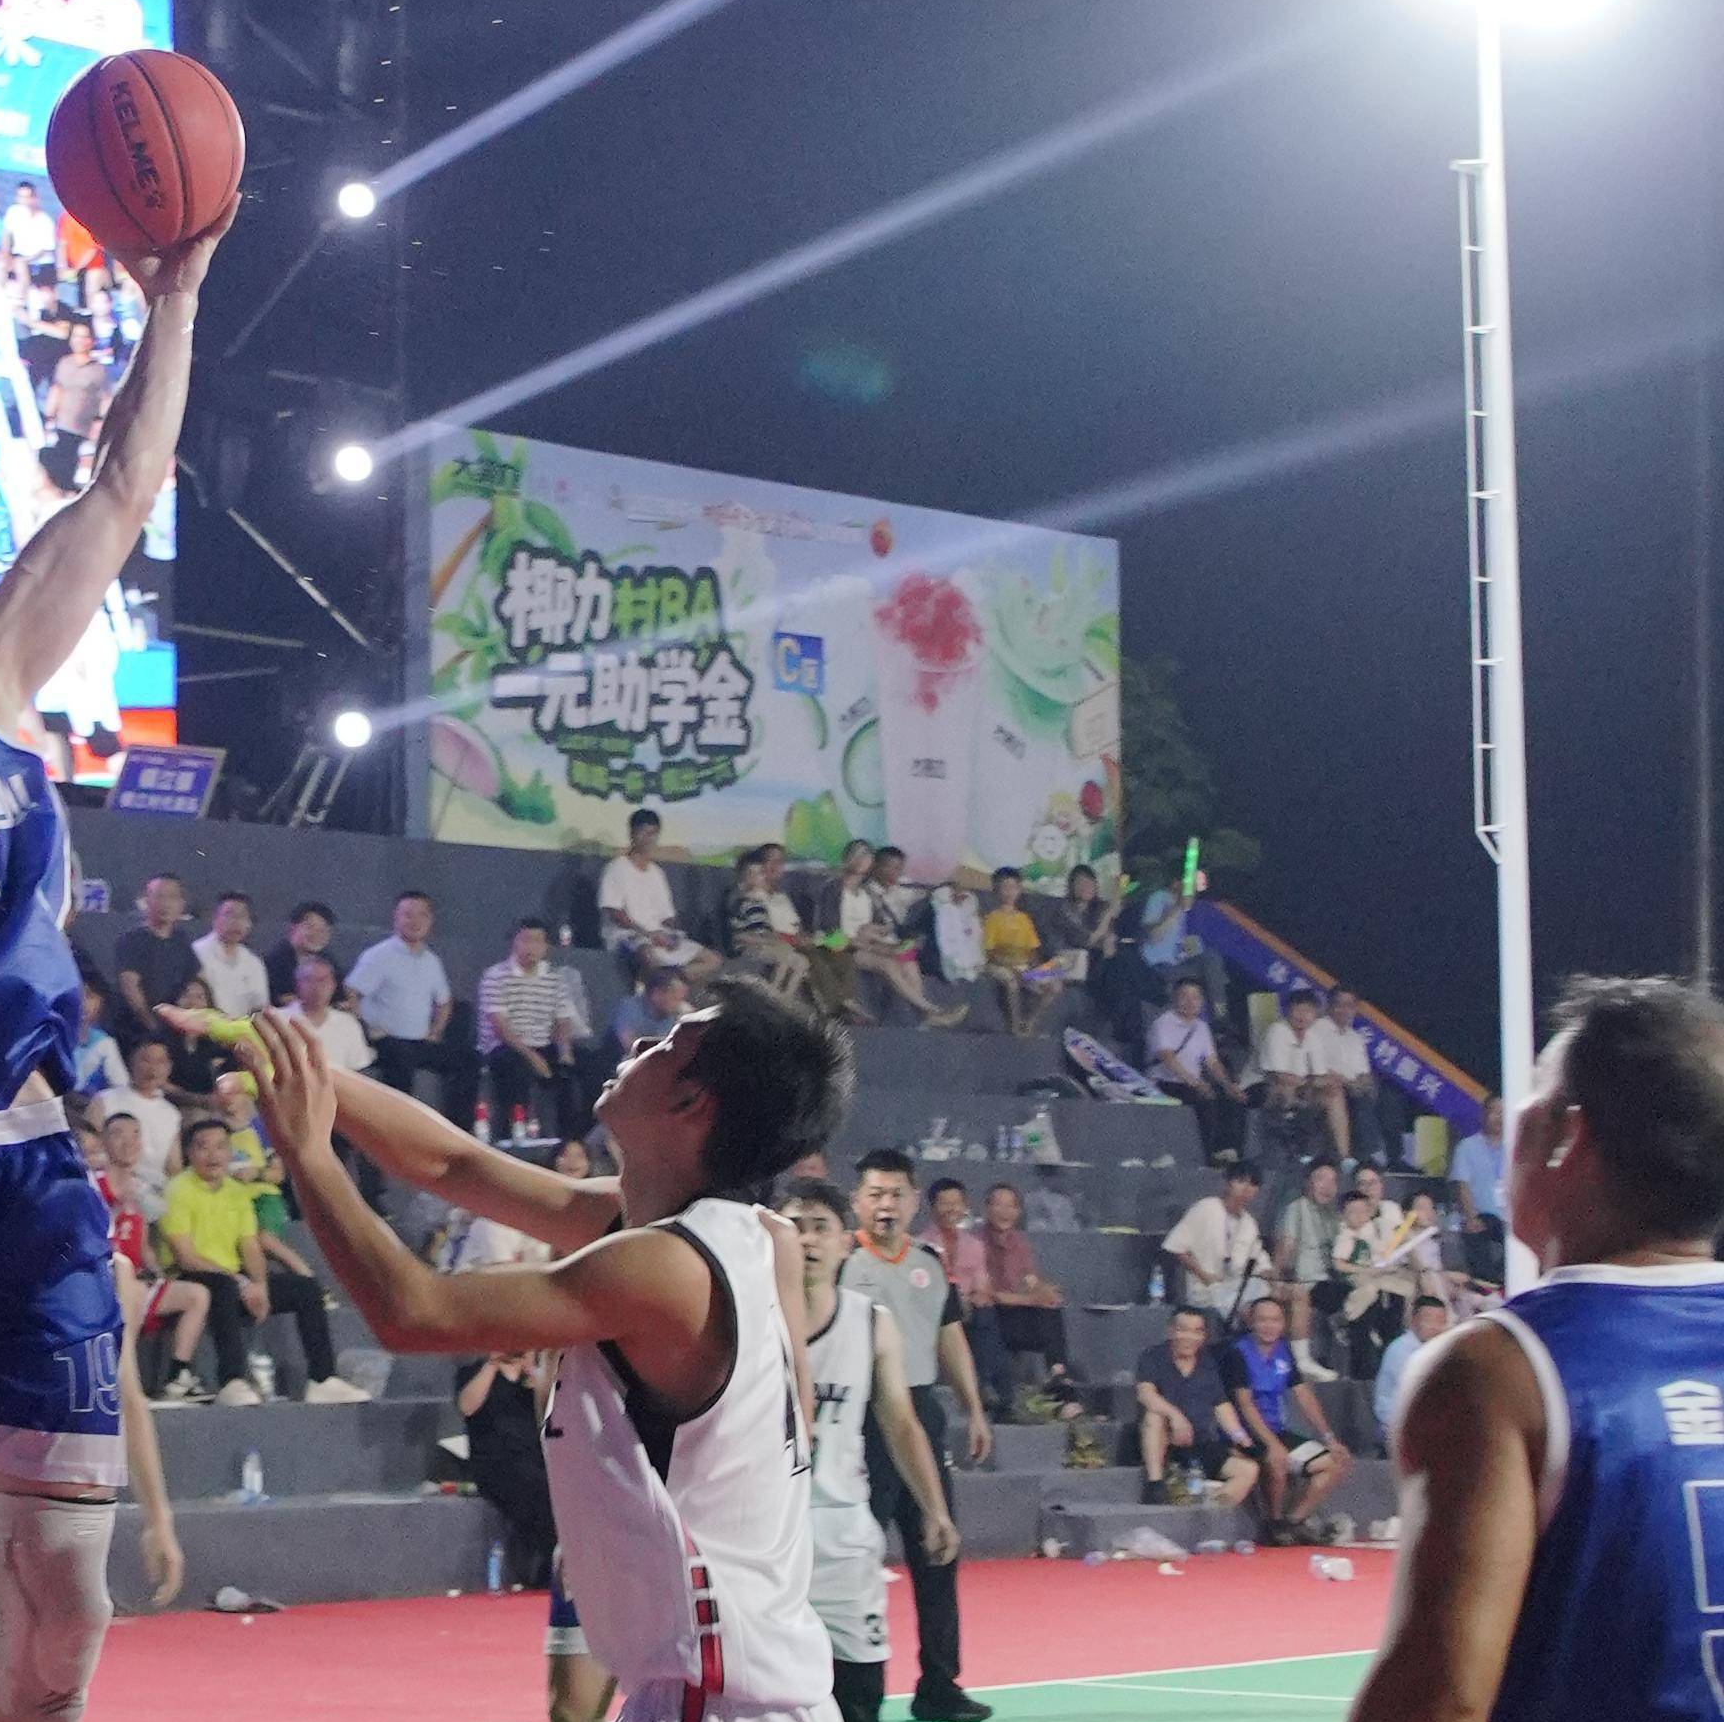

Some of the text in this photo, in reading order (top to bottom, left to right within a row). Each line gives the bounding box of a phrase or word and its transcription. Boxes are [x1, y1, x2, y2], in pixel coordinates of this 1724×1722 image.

[109, 80, 161, 194] KELME
[493, 650, 749, 749] 一元助学金
